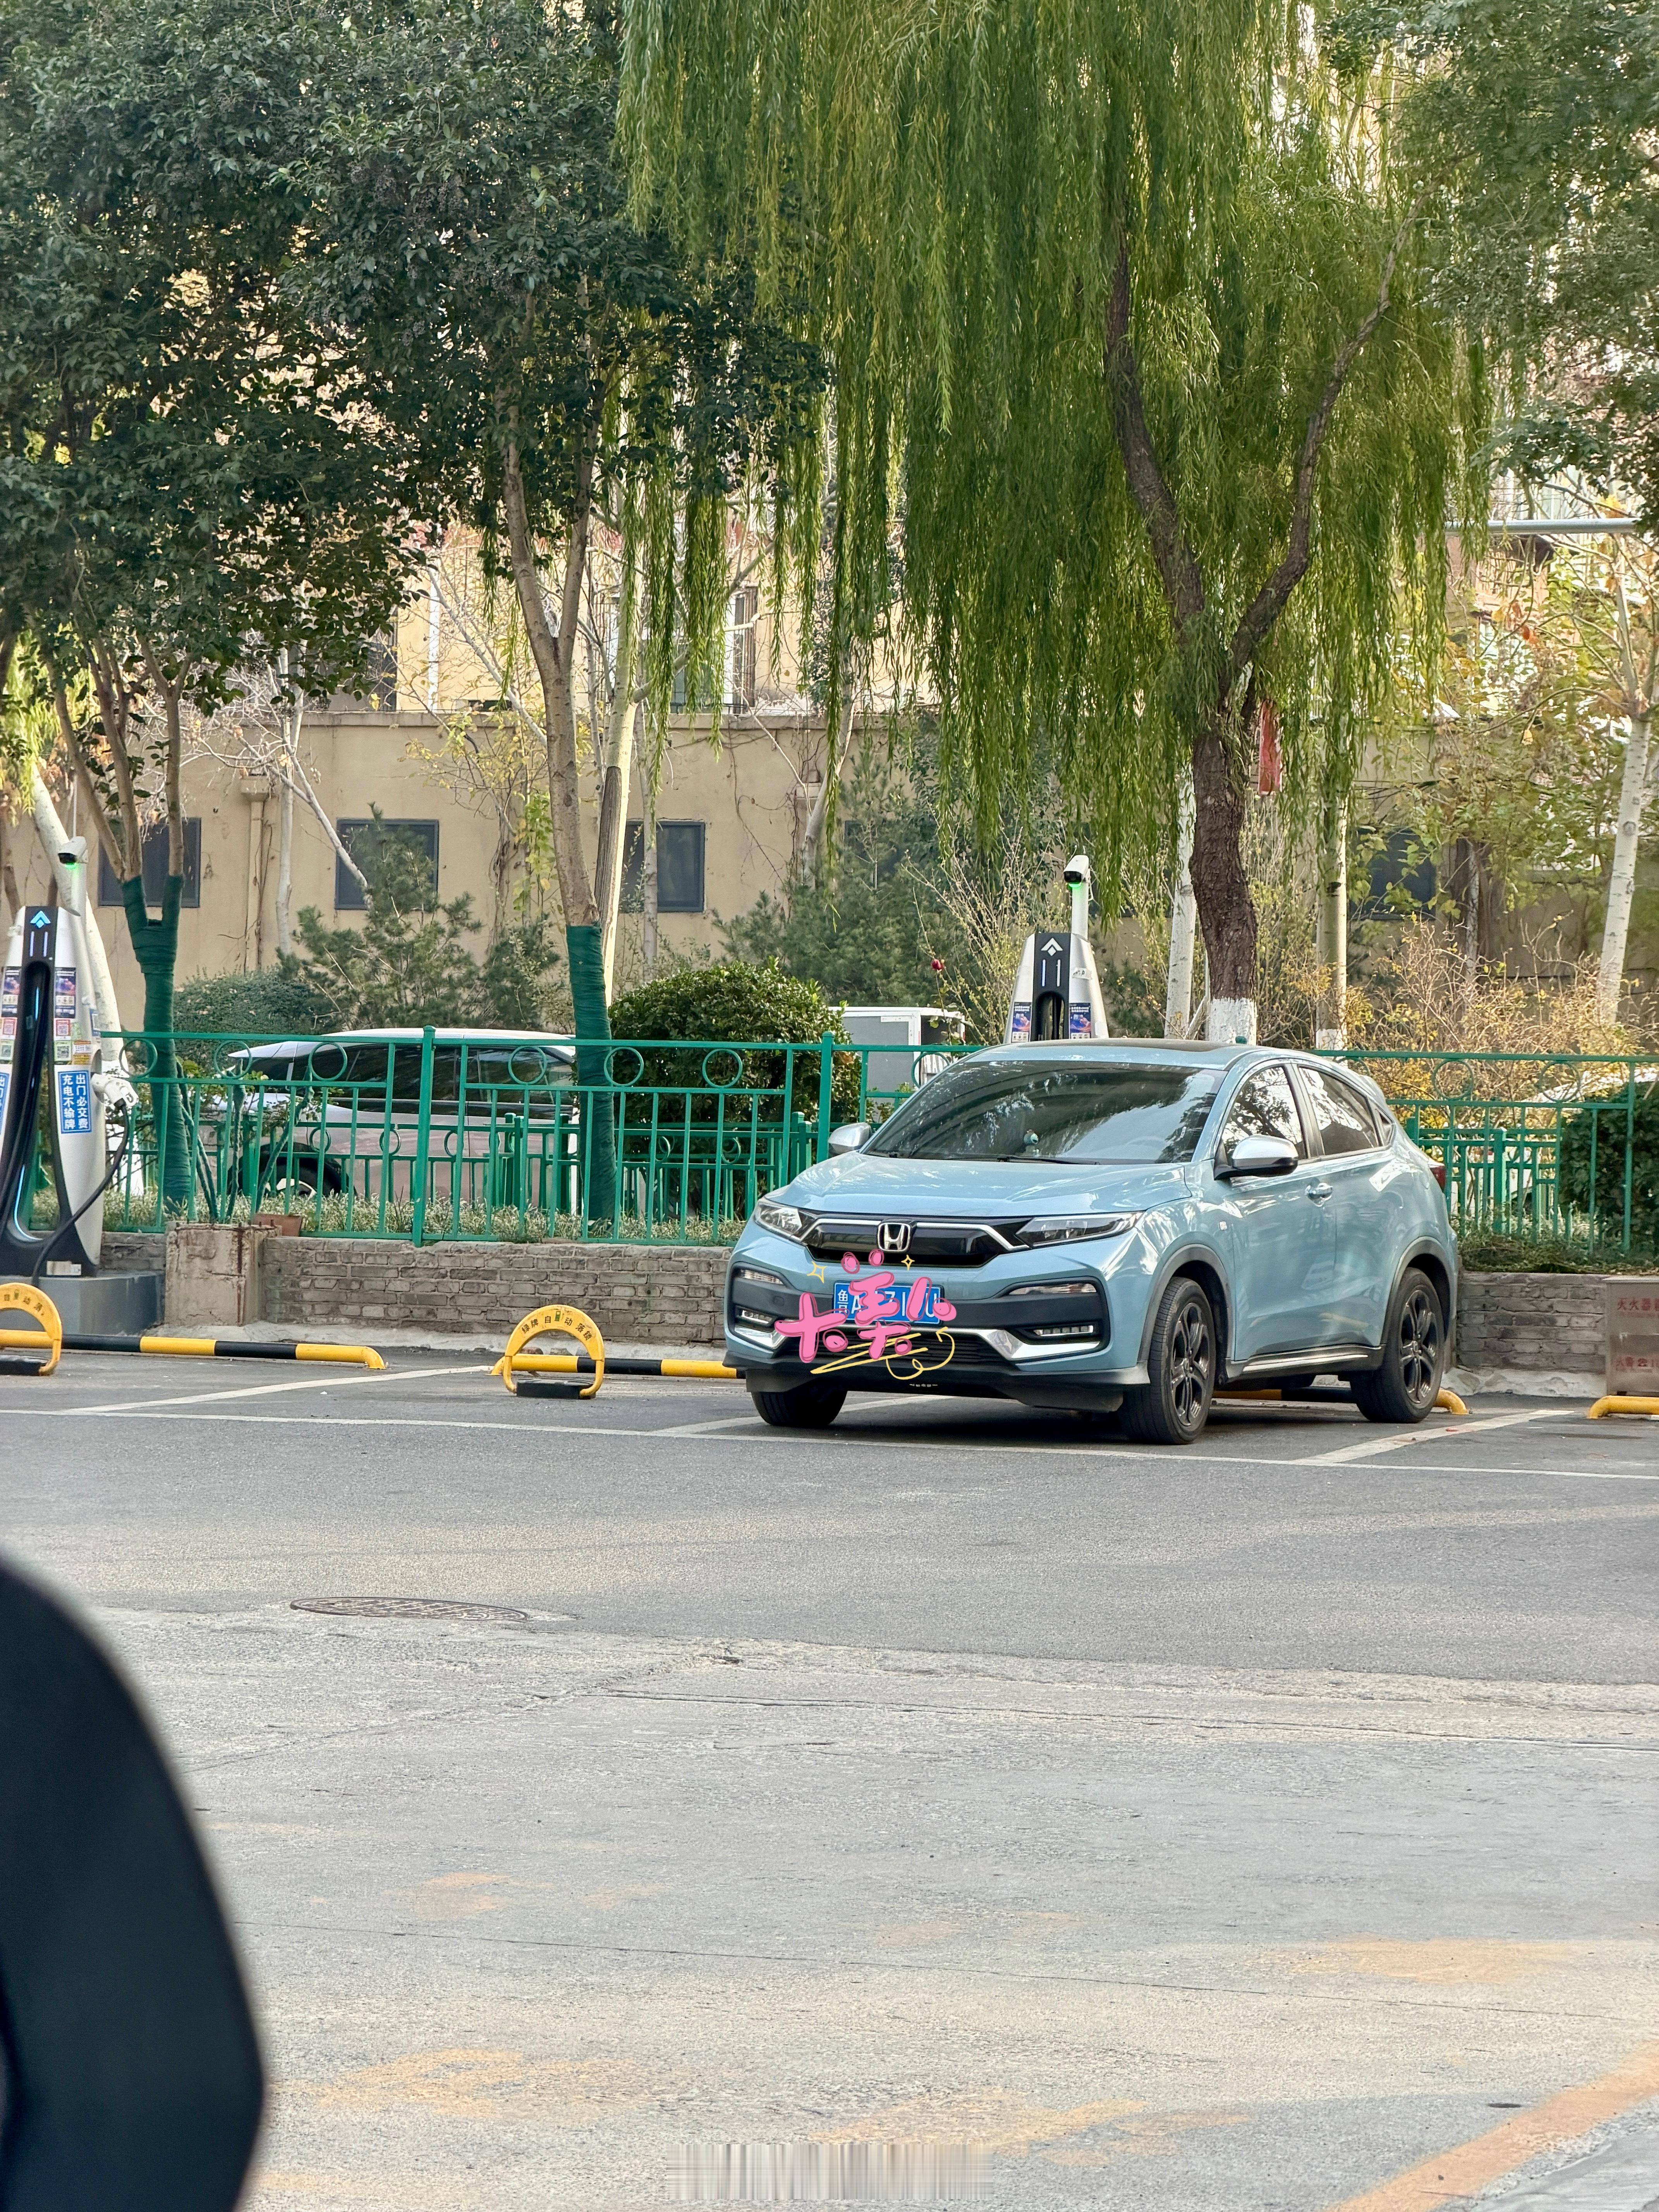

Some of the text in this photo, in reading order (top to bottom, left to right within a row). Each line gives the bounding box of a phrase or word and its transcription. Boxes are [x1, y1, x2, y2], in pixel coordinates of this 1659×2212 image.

[76, 1073, 88, 1129] 出门必交费
